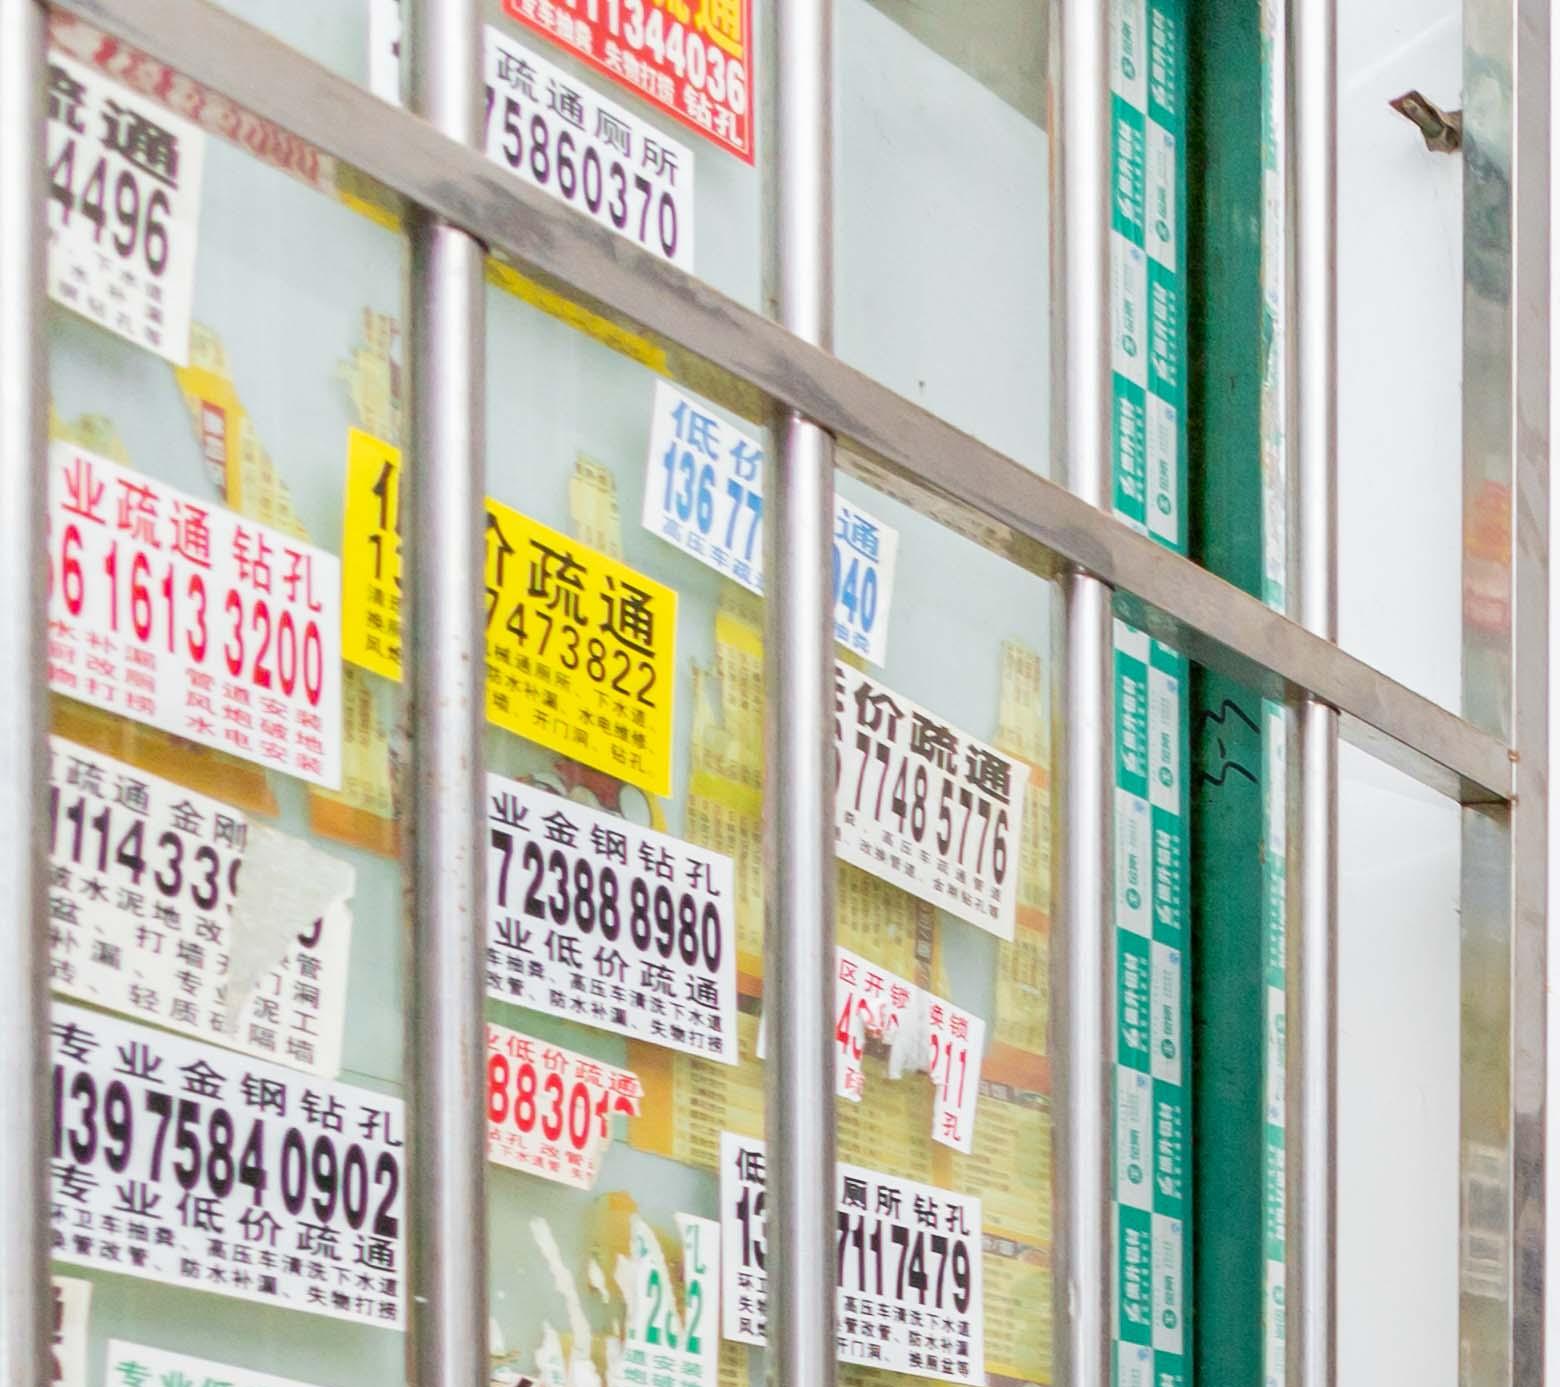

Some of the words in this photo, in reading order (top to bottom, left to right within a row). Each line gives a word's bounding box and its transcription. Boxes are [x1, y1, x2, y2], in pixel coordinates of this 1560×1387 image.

[497, 46, 679, 188] 疏通厕所
[684, 84, 745, 146] 钻孔
[662, 441, 716, 533] 136
[104, 538, 206, 662] 1613
[223, 590, 324, 707] 3200
[230, 524, 323, 613] 钻孔
[937, 776, 1008, 888] 5776
[523, 838, 621, 943] 2388
[630, 876, 722, 974] 8980
[52, 1020, 403, 1148] 专业金钢钻孔
[52, 1063, 134, 1175] 139
[144, 1090, 269, 1206] 7584
[281, 1127, 400, 1239] 0902
[52, 1162, 396, 1274] 专业低价疏通
[891, 1222, 972, 1316] 7479
[911, 1193, 971, 1237] 钻孔
